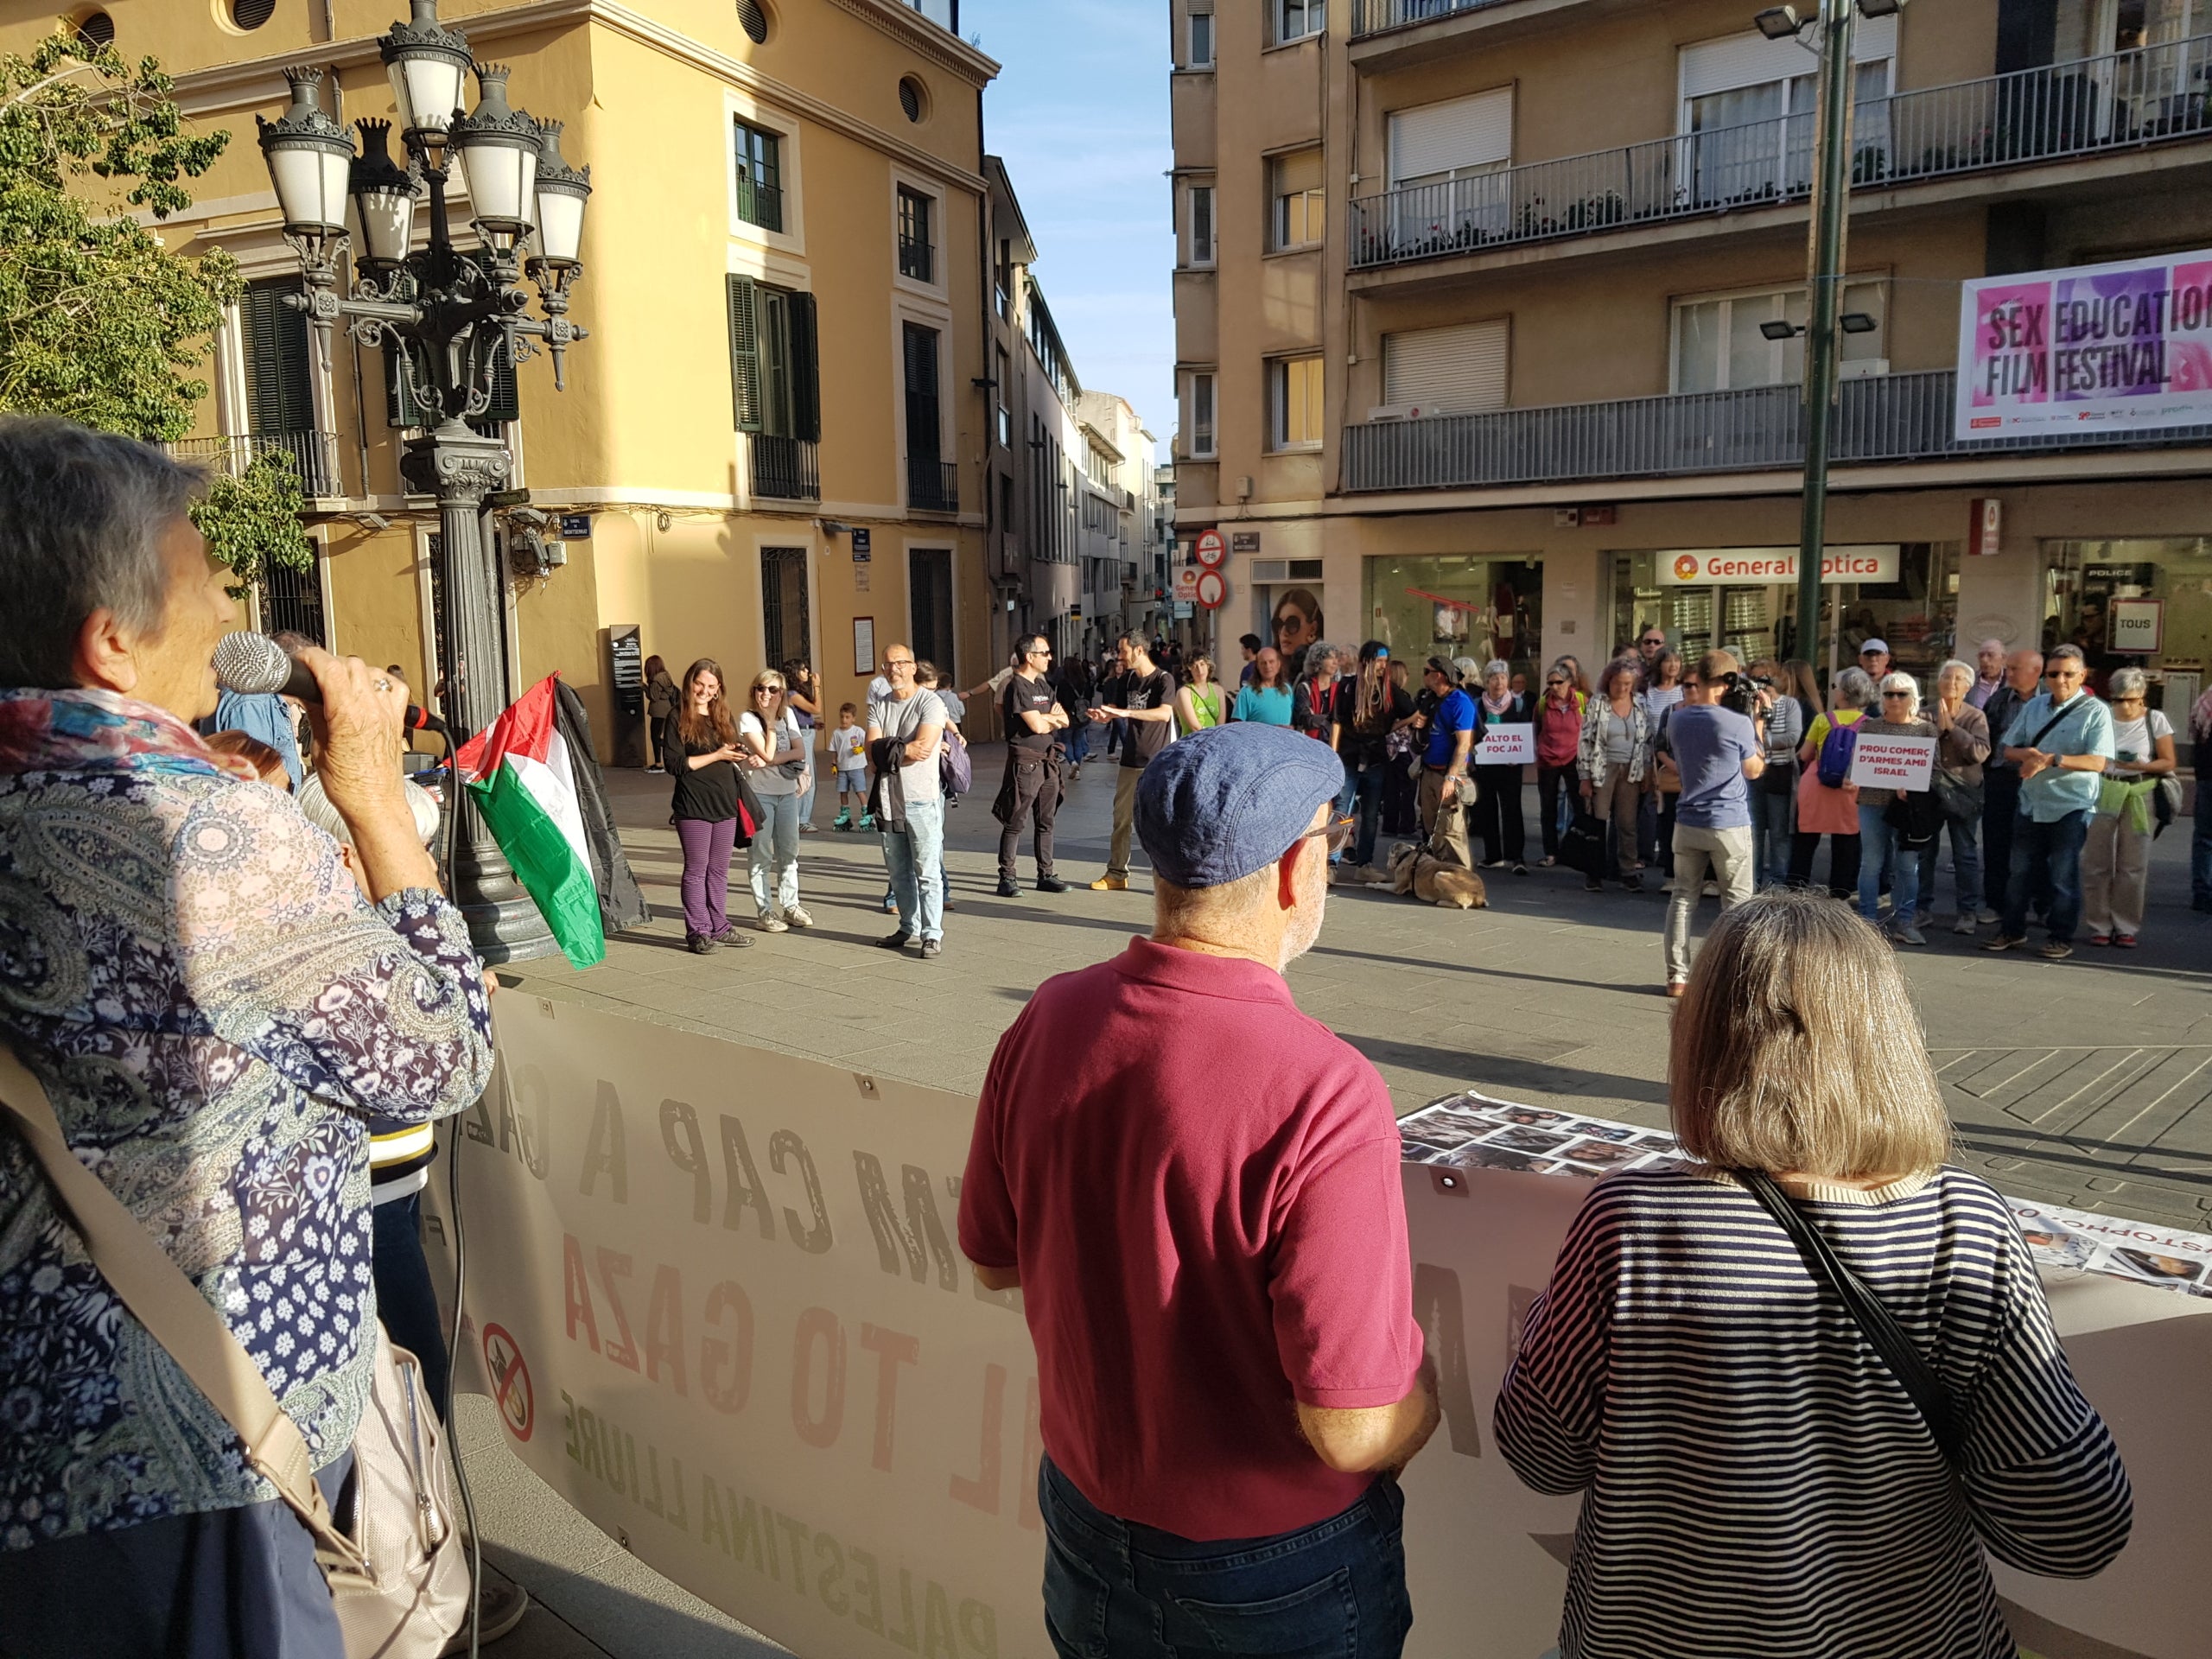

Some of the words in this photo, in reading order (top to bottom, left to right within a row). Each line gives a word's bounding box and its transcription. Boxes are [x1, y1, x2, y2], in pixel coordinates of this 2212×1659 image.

[1988, 303, 2044, 350] SEX
[1985, 349, 2048, 397] FILM
[2054, 340, 2172, 392] FESTIVAL
[1707, 556, 1795, 576] General
[1821, 554, 1878, 579] ptica
[2120, 619, 2151, 629] TOUS
[1484, 734, 1510, 743] ALTO
[1486, 745, 1506, 753] FOC
[1859, 745, 1888, 753] PROU
[1889, 747, 1930, 758] COMERÇ
[1859, 755, 1903, 766] D'ARMES
[1904, 759, 1927, 767] AMB
[1873, 766, 1909, 777] ISRAEL
